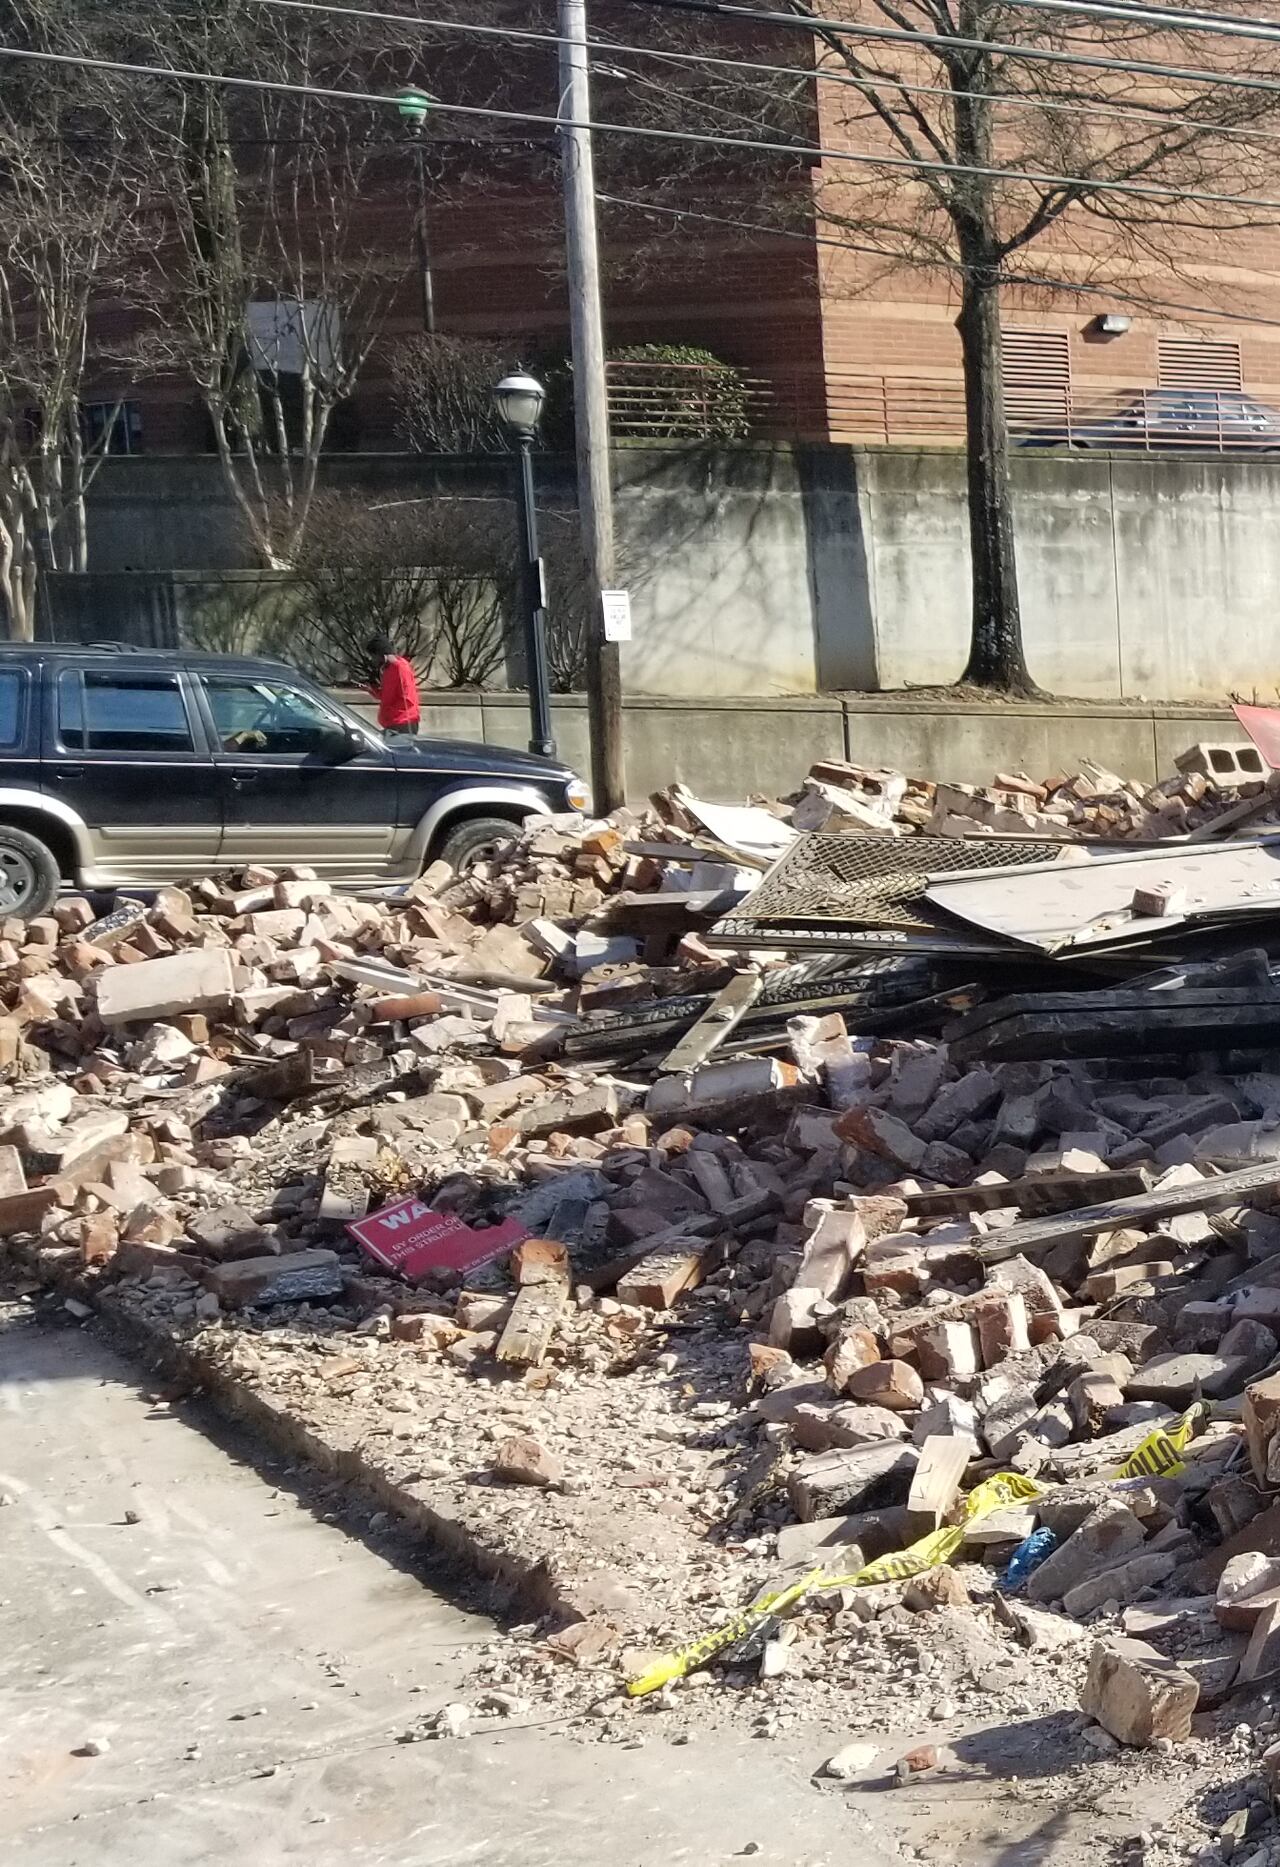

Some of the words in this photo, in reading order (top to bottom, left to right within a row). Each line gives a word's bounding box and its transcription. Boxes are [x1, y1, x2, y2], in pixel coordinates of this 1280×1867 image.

[392, 1239, 407, 1251] BY
[408, 1222, 445, 1243] ORDER
[391, 1246, 414, 1261] THIS
